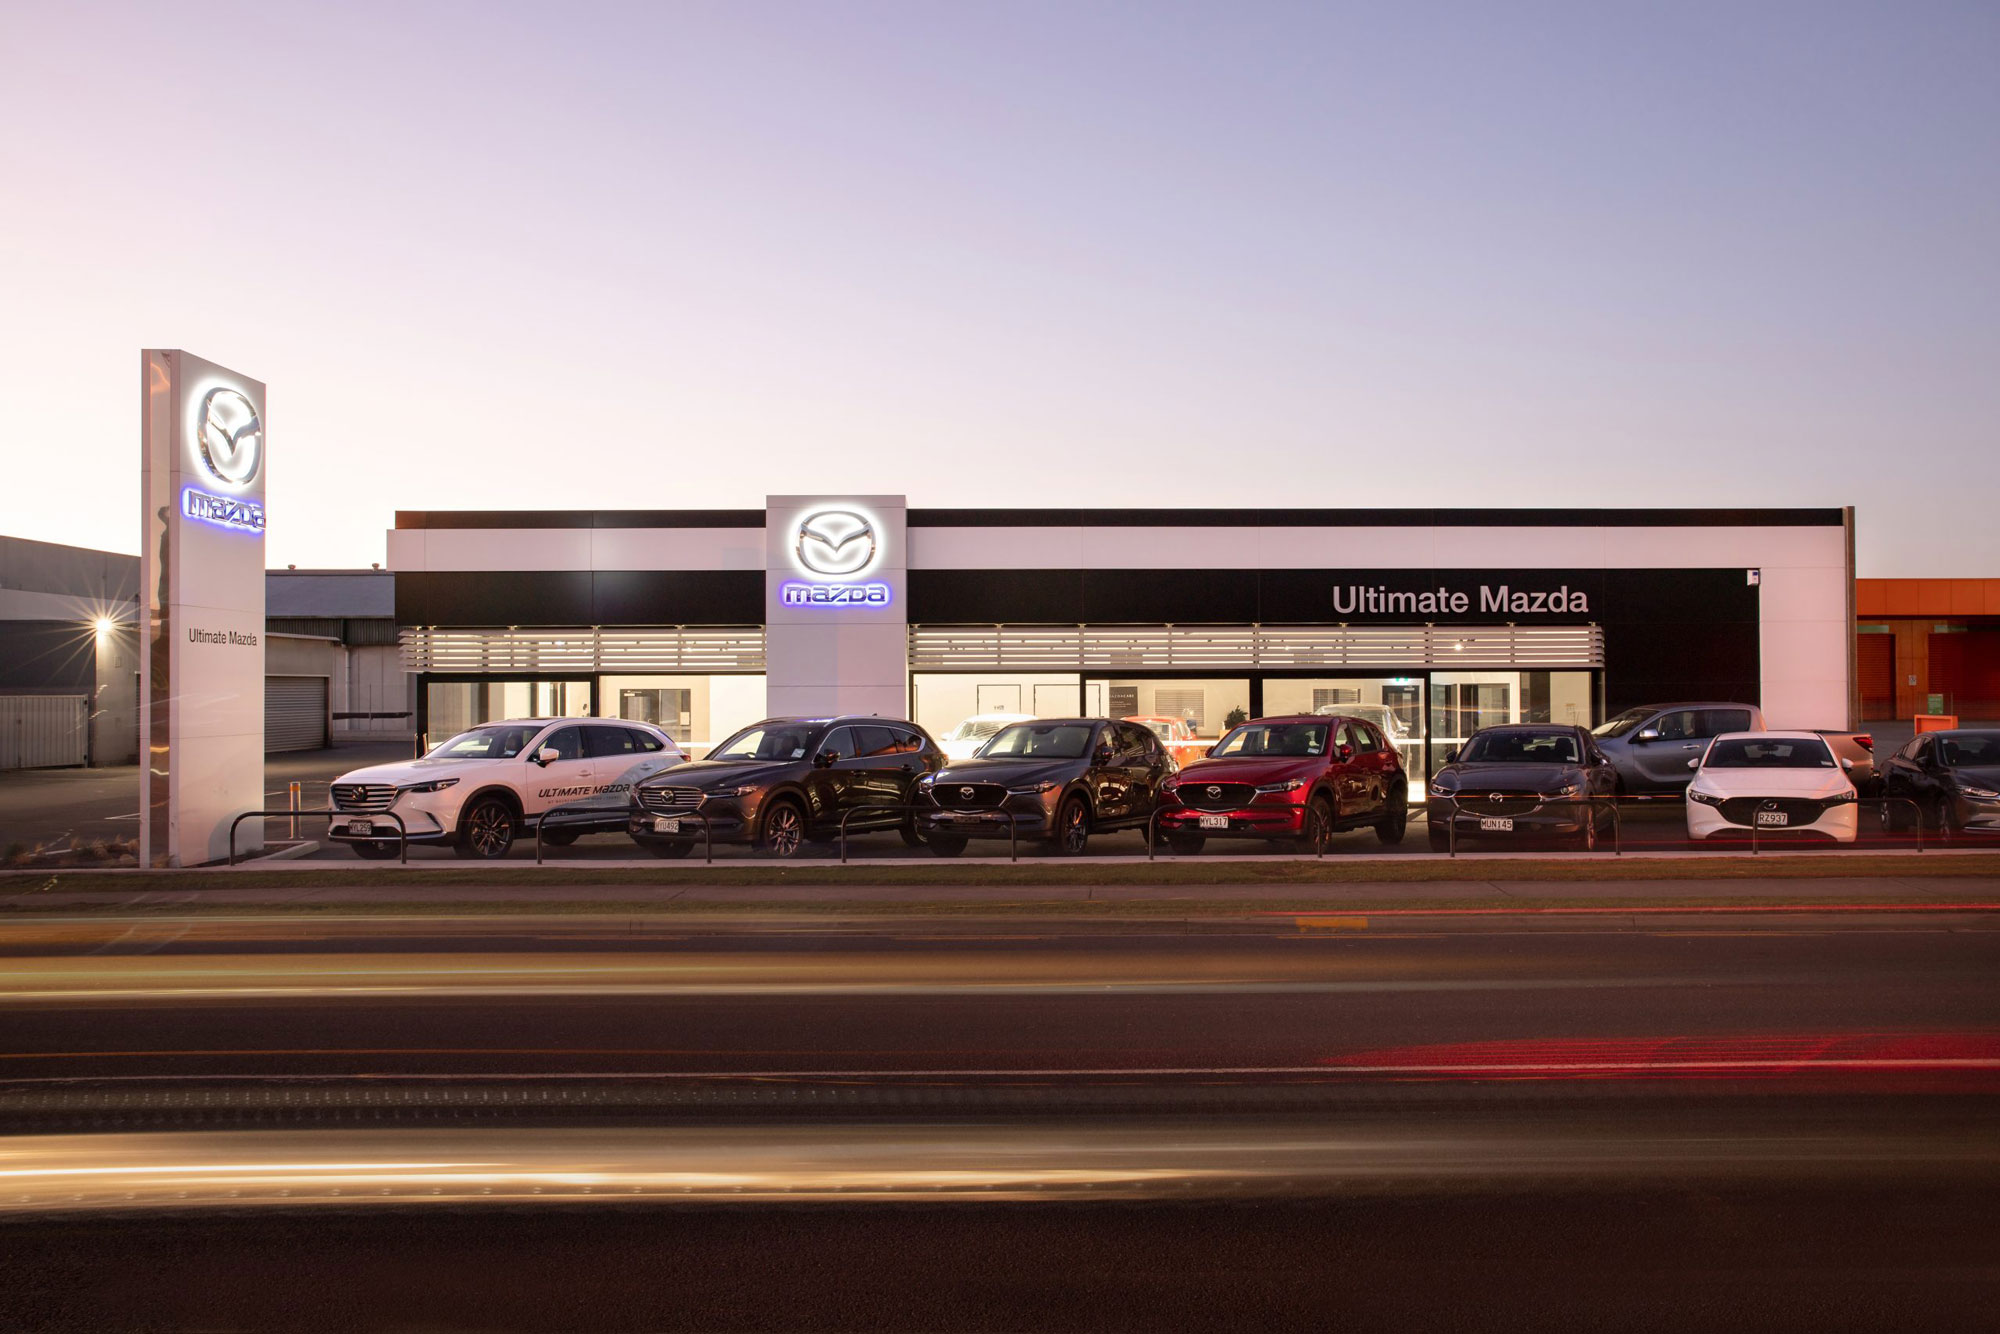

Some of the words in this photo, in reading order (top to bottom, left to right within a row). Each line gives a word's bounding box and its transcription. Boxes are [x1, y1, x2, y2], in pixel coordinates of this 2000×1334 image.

[188, 490, 266, 528] mazda
[786, 586, 886, 603] mazda
[1332, 585, 1469, 614] Ultimate
[1479, 585, 1589, 614] Mazda
[189, 628, 227, 645] Ultimate
[229, 630, 257, 646] Mazda
[538, 786, 592, 799] ULTIMATE
[1200, 817, 1228, 826] MYL317
[1481, 820, 1512, 829] MUN145
[1758, 813, 1787, 824] RZ937
